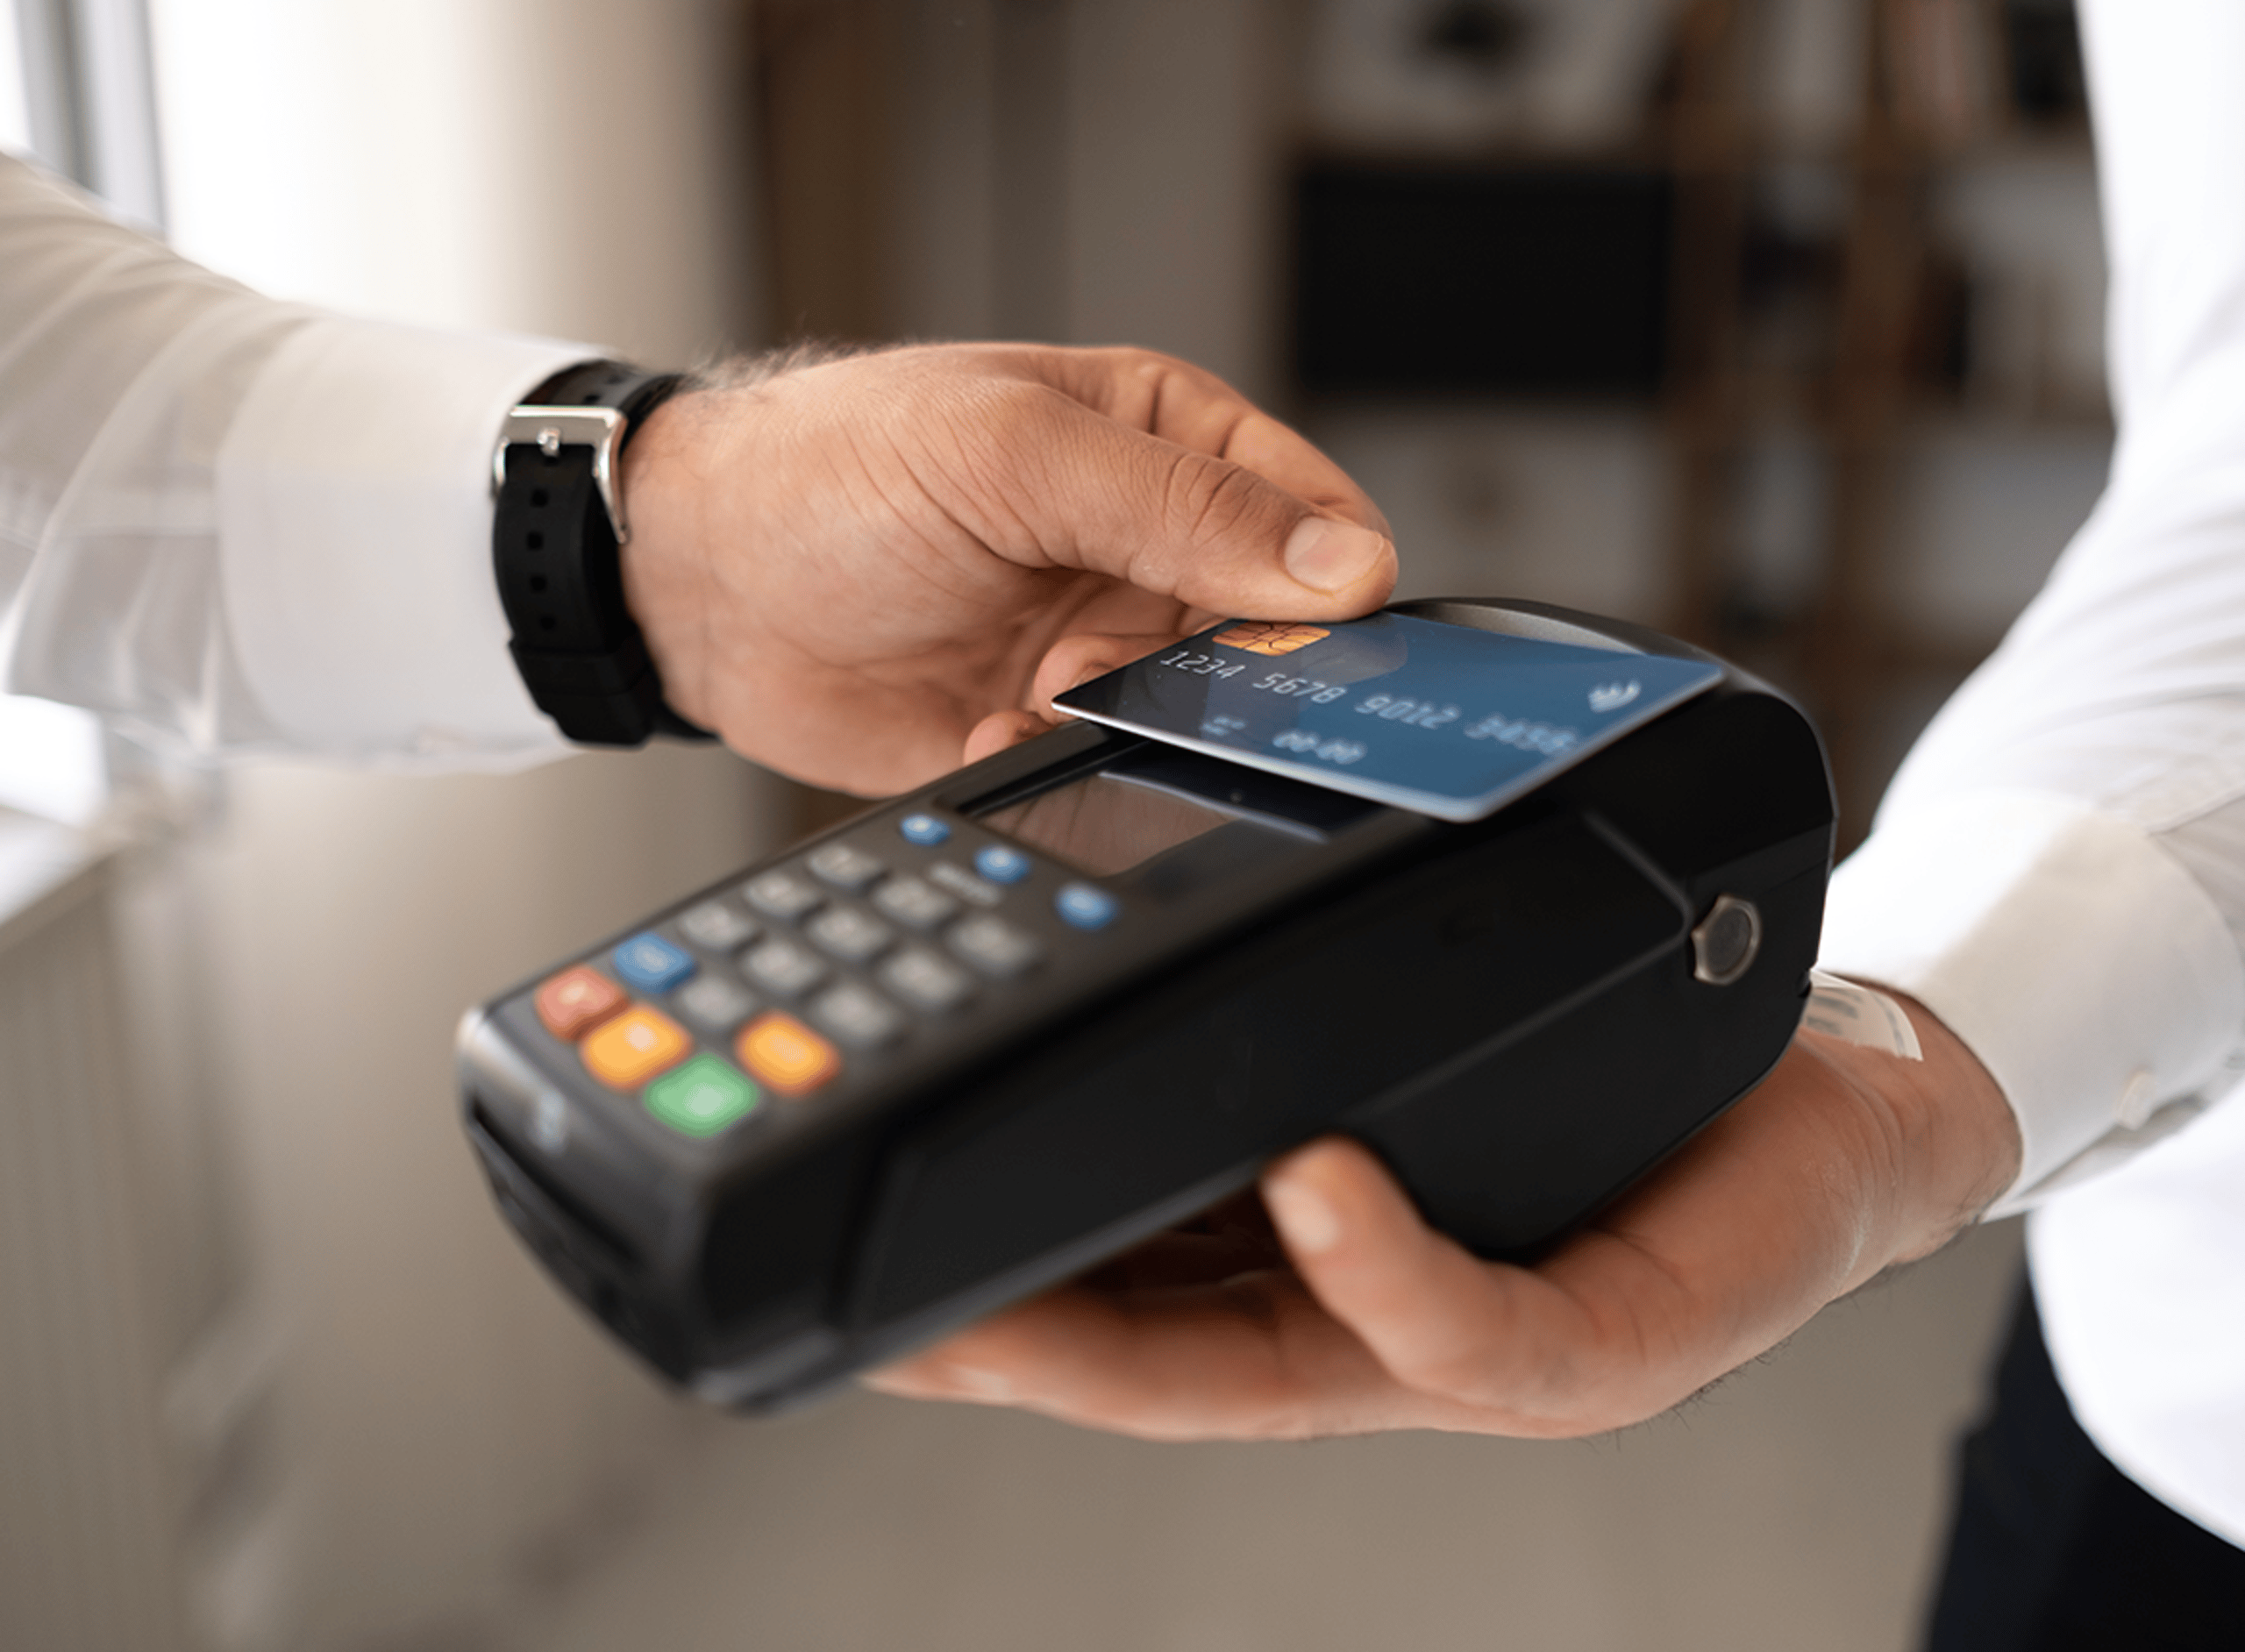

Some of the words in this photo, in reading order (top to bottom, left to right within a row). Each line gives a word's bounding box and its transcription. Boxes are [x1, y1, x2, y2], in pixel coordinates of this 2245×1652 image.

[1159, 651, 1246, 680] 1234
[1252, 673, 1348, 703] 5678
[1354, 695, 1459, 730] 9012
